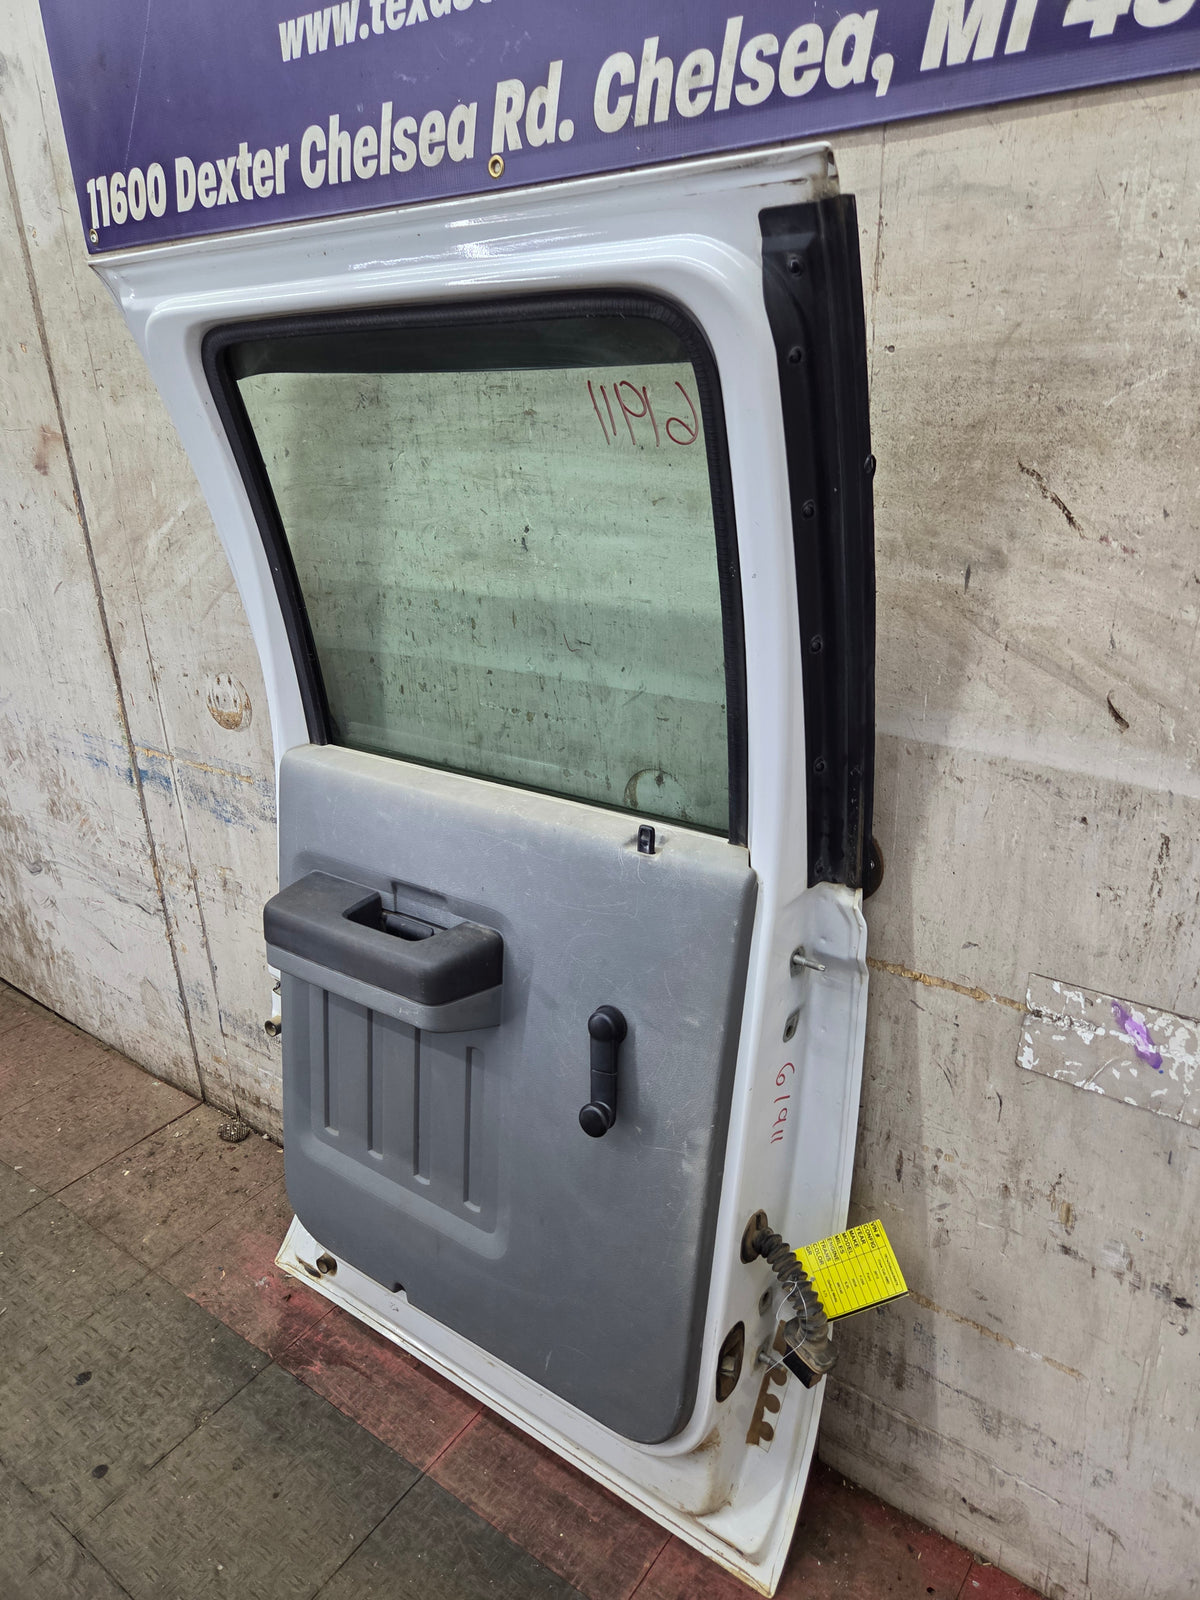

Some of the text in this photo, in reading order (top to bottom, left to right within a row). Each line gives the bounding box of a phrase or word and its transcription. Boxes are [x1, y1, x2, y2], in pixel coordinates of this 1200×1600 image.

[87, 162, 166, 229] 11600
[175, 144, 290, 213] Dexter
[300, 101, 478, 189] Chelsea
[491, 60, 574, 153] Rd.
[594, 9, 894, 133] Chelsea,
[920, 0, 1038, 72] MI
[834, 1235, 846, 1255] MILES
[841, 1232, 853, 1255] MODEL
[849, 1230, 860, 1248] MAKE
[856, 1227, 867, 1245] YEAR
[863, 1224, 877, 1249] CONFIG
[805, 1246, 813, 1256] GR
[812, 1243, 824, 1265] COLOR
[819, 1241, 832, 1262] TRANS
[826, 1237, 840, 1261] ENGINE
